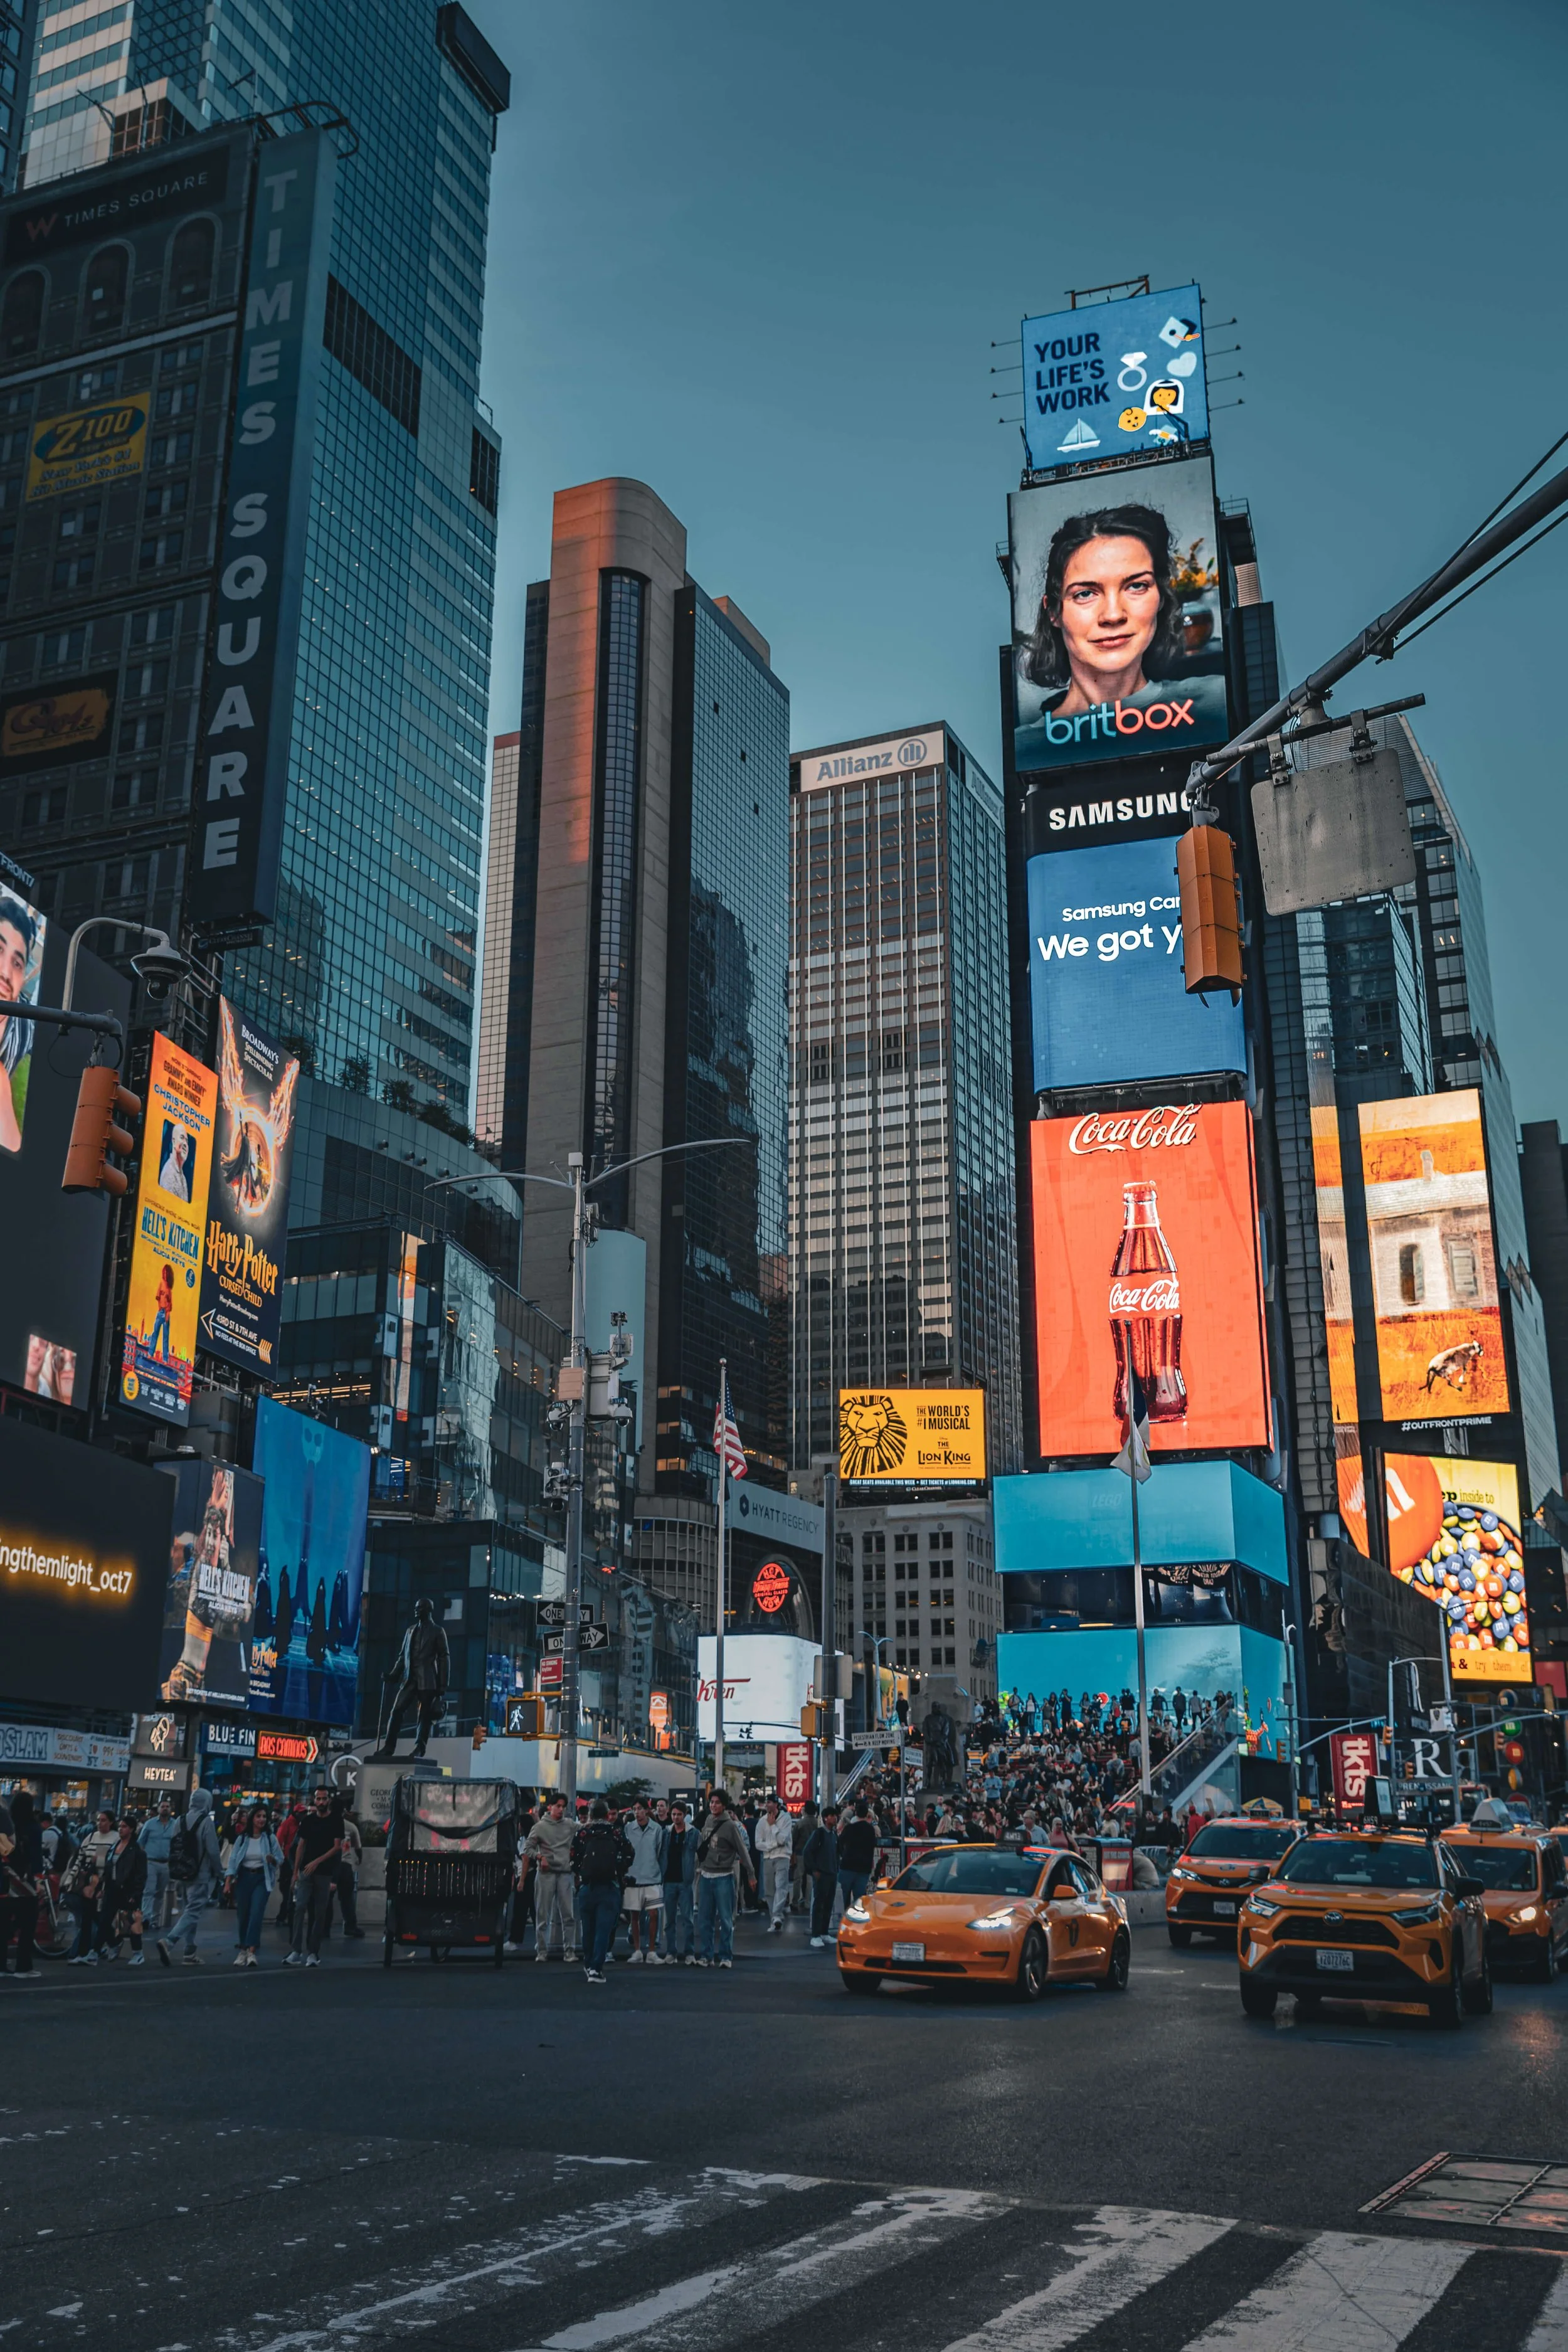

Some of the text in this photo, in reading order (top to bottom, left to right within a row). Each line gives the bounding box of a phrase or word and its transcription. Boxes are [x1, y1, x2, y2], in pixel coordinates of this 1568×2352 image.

[26, 171, 208, 243] W TIMES SQUARE
[238, 169, 298, 446] TIMES
[1035, 332, 1101, 364] YOUR
[1036, 358, 1105, 391] LIFE'S
[1036, 381, 1111, 415] WORK
[44, 408, 134, 462] Z100
[95, 462, 140, 481] Station
[203, 492, 268, 871] SQUARE
[1045, 698, 1195, 745] britbox
[817, 751, 893, 781] Allianz
[1049, 790, 1198, 831] SAMSUNG
[0, 851, 35, 887] FRONT/
[1062, 896, 1180, 922] Samsung Car
[1037, 933, 1089, 961] We
[1096, 923, 1154, 961] got
[241, 1024, 280, 1065] BROADWAY'S
[243, 1051, 273, 1083] SPECTACULAR
[154, 1084, 211, 1130] CHRISTOPHER
[167, 1076, 201, 1109] AWARD WINNER
[162, 1102, 201, 1133] JACKSON
[1068, 1103, 1203, 1155] Coca-Cola
[141, 1205, 167, 1242] HELL'S
[167, 1221, 199, 1260] KITCHEN
[152, 1246, 186, 1268] ALICIA KEYS
[206, 1219, 244, 1278] Harry
[242, 1232, 278, 1296] Potter
[219, 1274, 244, 1297] CURSED
[243, 1289, 263, 1308] CHILD
[1109, 1279, 1180, 1313] Coca-Cola
[216, 1314, 258, 1343] 43RD ST & 7TH AVE
[928, 1405, 970, 1417] WORLD'S
[928, 1417, 970, 1430] MUSICAL
[1401, 1416, 1493, 1432] #OUTFRONTPRIME
[918, 1450, 971, 1465] LION KING
[1459, 1488, 1485, 1503] inside
[1485, 1492, 1495, 1504] to
[752, 1503, 820, 1534] HYATT REGENCY
[0, 1539, 132, 1594] ngthemlight_oct7
[762, 1567, 780, 1579] HOT
[198, 1564, 222, 1594] HELL'S
[222, 1569, 251, 1604] KITCHEN
[545, 1609, 563, 1619] ONE
[762, 1596, 780, 1609] NOW
[553, 1631, 598, 1648] ON WAY
[1458, 1658, 1468, 1670] &
[208, 1724, 256, 1746] BLUE FIN
[259, 1735, 275, 1756] DOS
[276, 1737, 308, 1759] CAMINOS
[785, 1745, 808, 1799] tkts
[1342, 1737, 1370, 1798] tkts
[1411, 1738, 1454, 1779] R
[144, 1767, 176, 1783] HEYTEA
[346, 1772, 358, 1787] K
